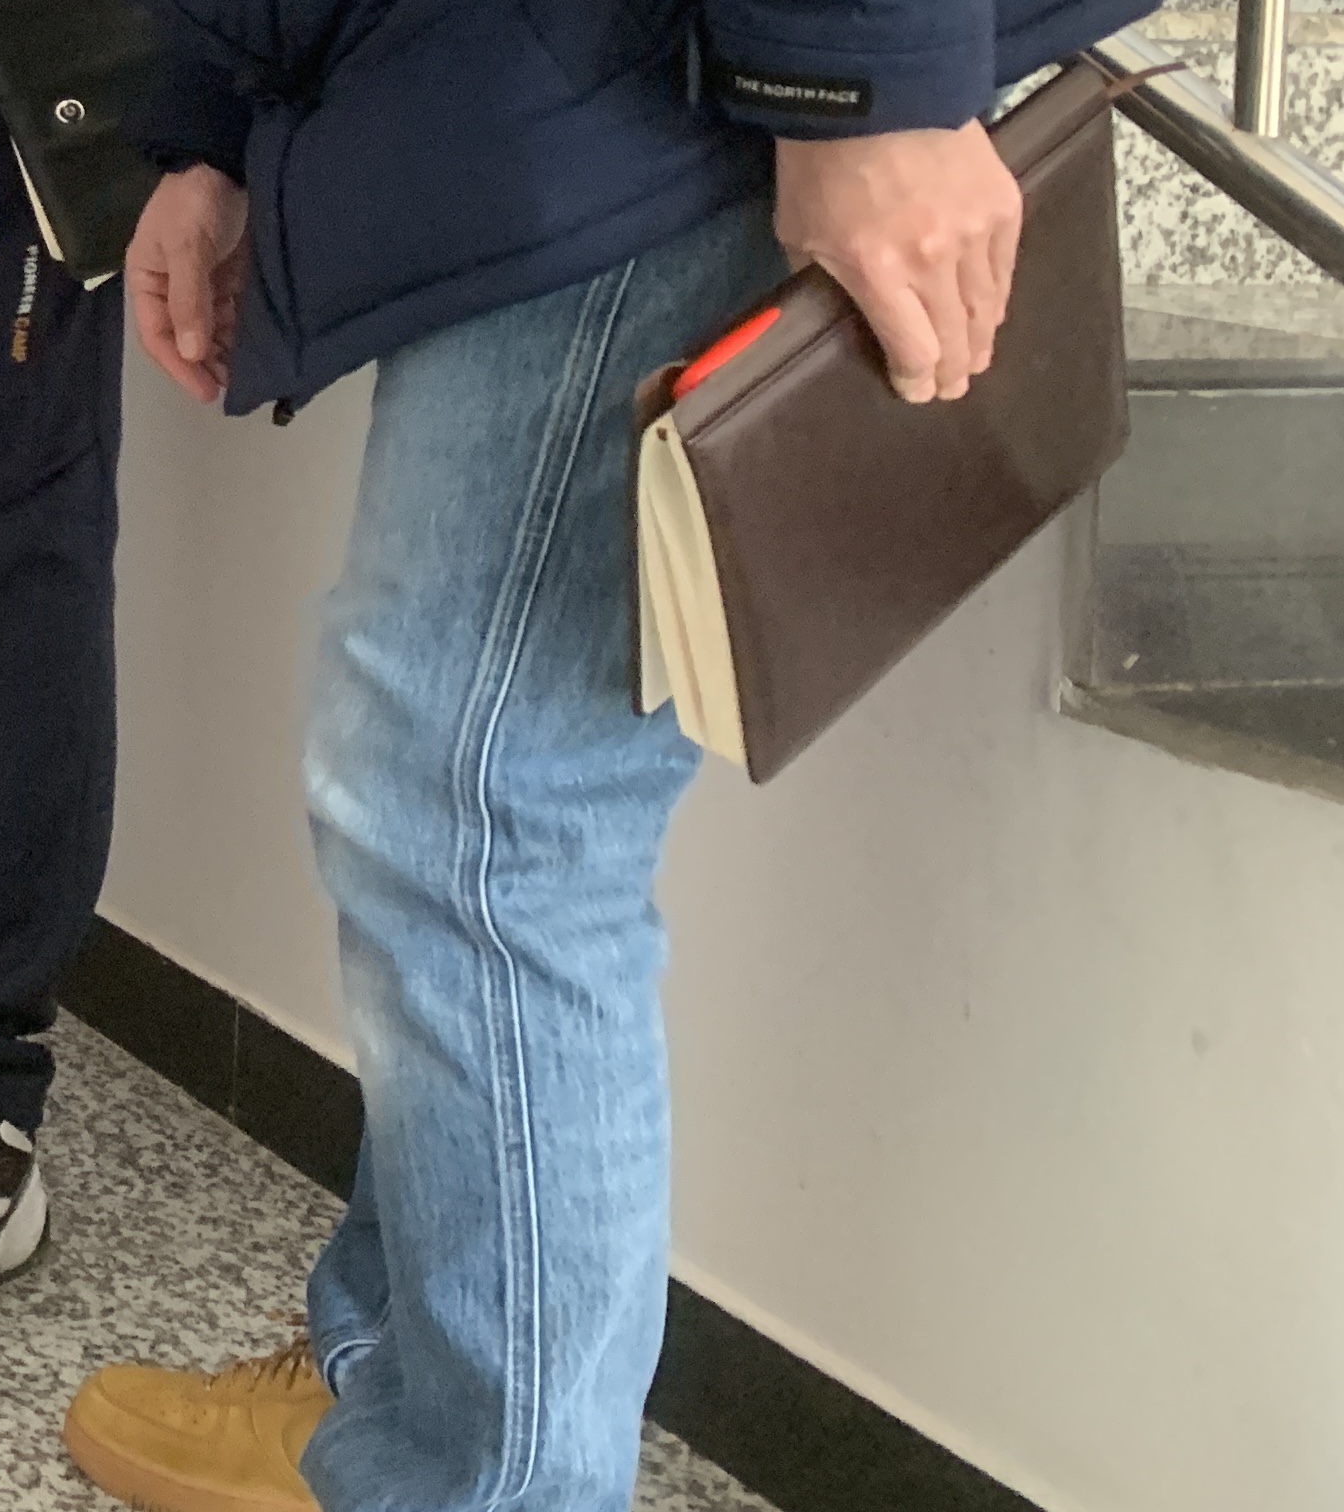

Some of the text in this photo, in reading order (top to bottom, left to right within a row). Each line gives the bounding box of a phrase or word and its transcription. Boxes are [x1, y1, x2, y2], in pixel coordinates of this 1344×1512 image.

[735, 75, 860, 104] THE NORTH FACE
